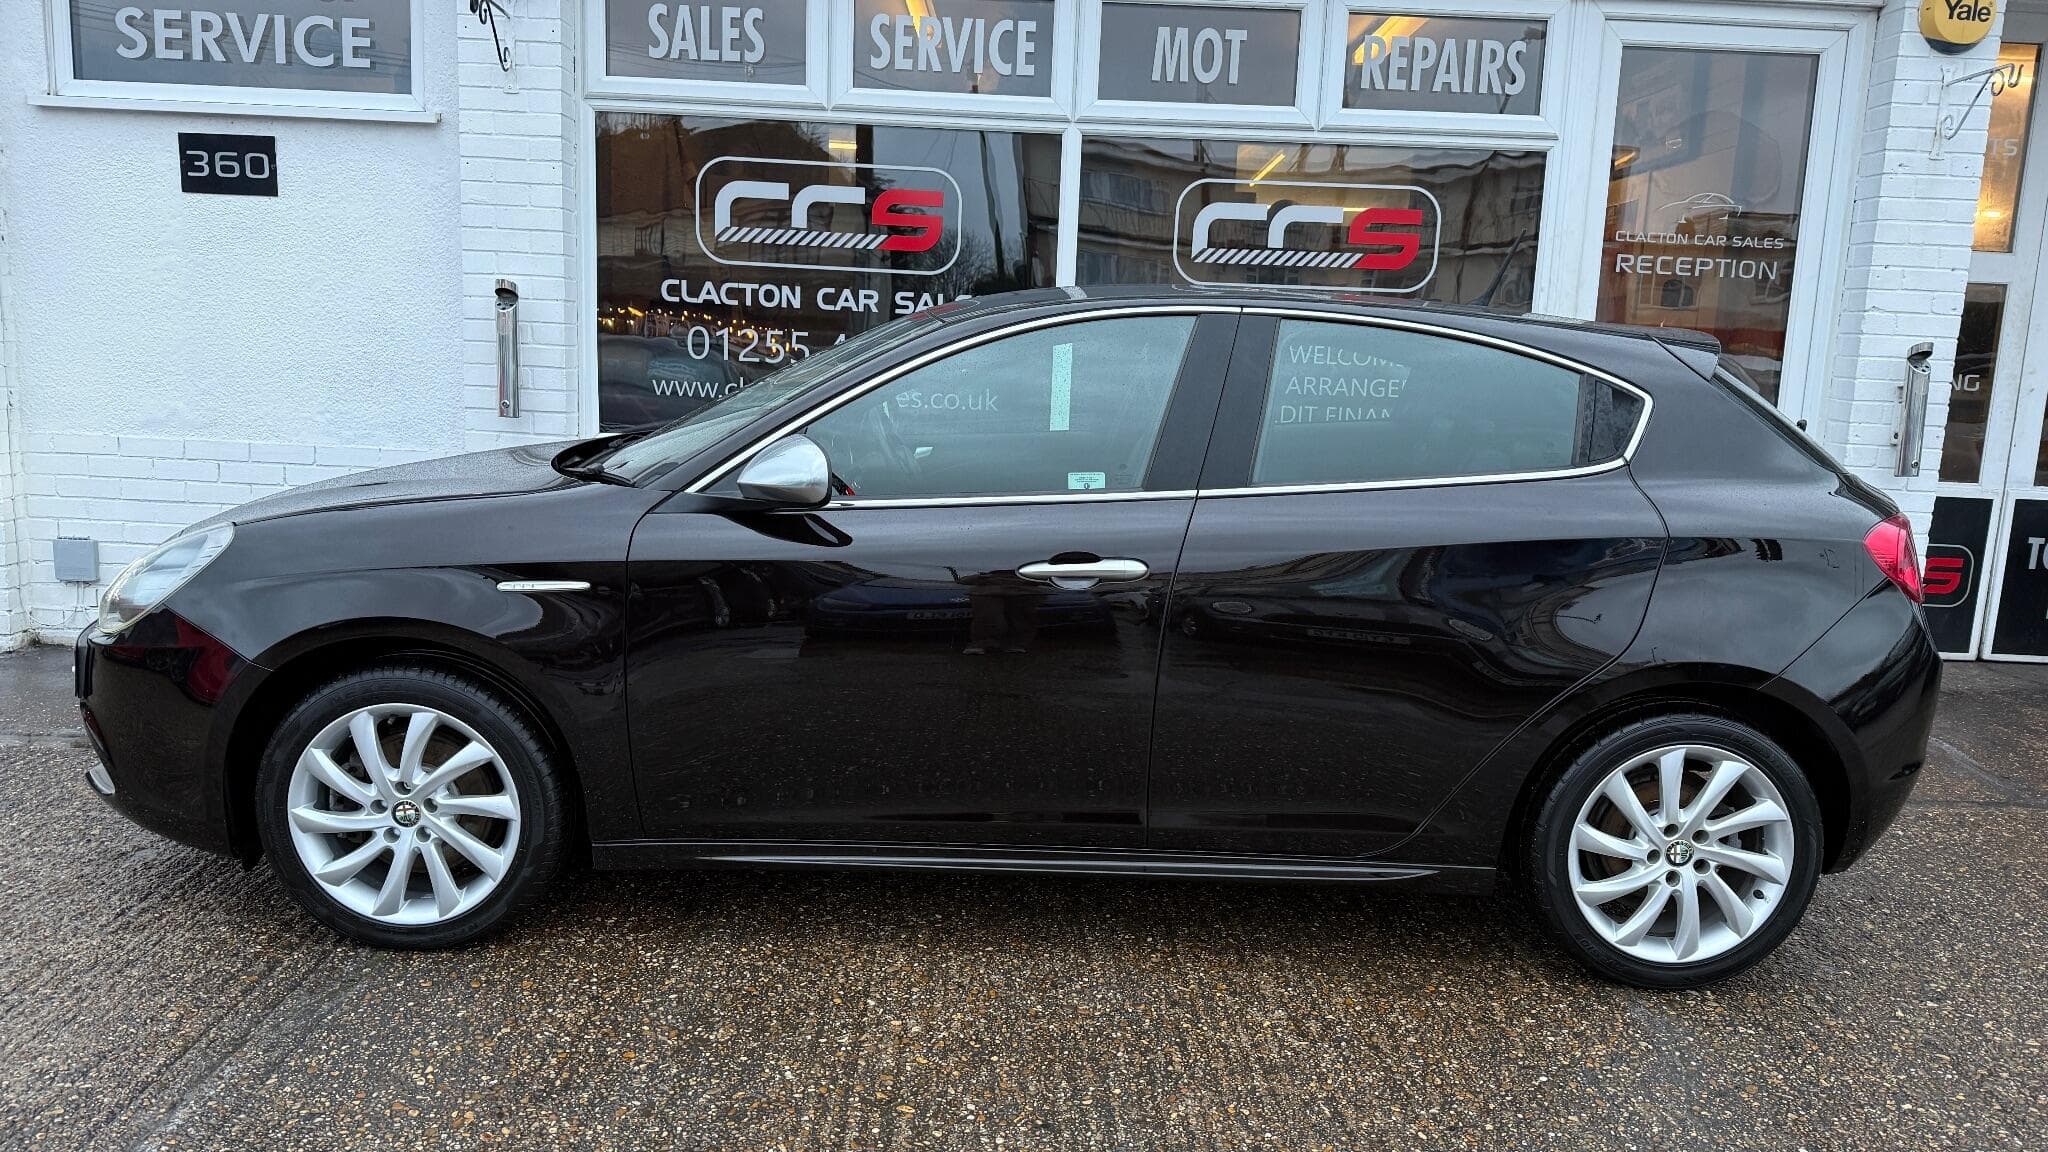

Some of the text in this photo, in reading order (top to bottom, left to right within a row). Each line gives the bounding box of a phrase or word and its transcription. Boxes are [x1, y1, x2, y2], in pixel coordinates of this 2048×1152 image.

[1945, 0, 1992, 23] Yale
[114, 6, 371, 69] SERVICE
[647, 2, 765, 63] SALES
[870, 13, 1037, 76] SERVICE
[1150, 26, 1248, 84] MOT
[1360, 35, 1527, 96] REPAIRS
[186, 150, 271, 180] 360
[1615, 230, 1785, 249] CLACTON CAR SALES
[1615, 253, 1778, 280] RECEPTION
[660, 278, 801, 309] CLACTON
[816, 287, 879, 314] CAR
[1289, 345, 1405, 367] WELCO
